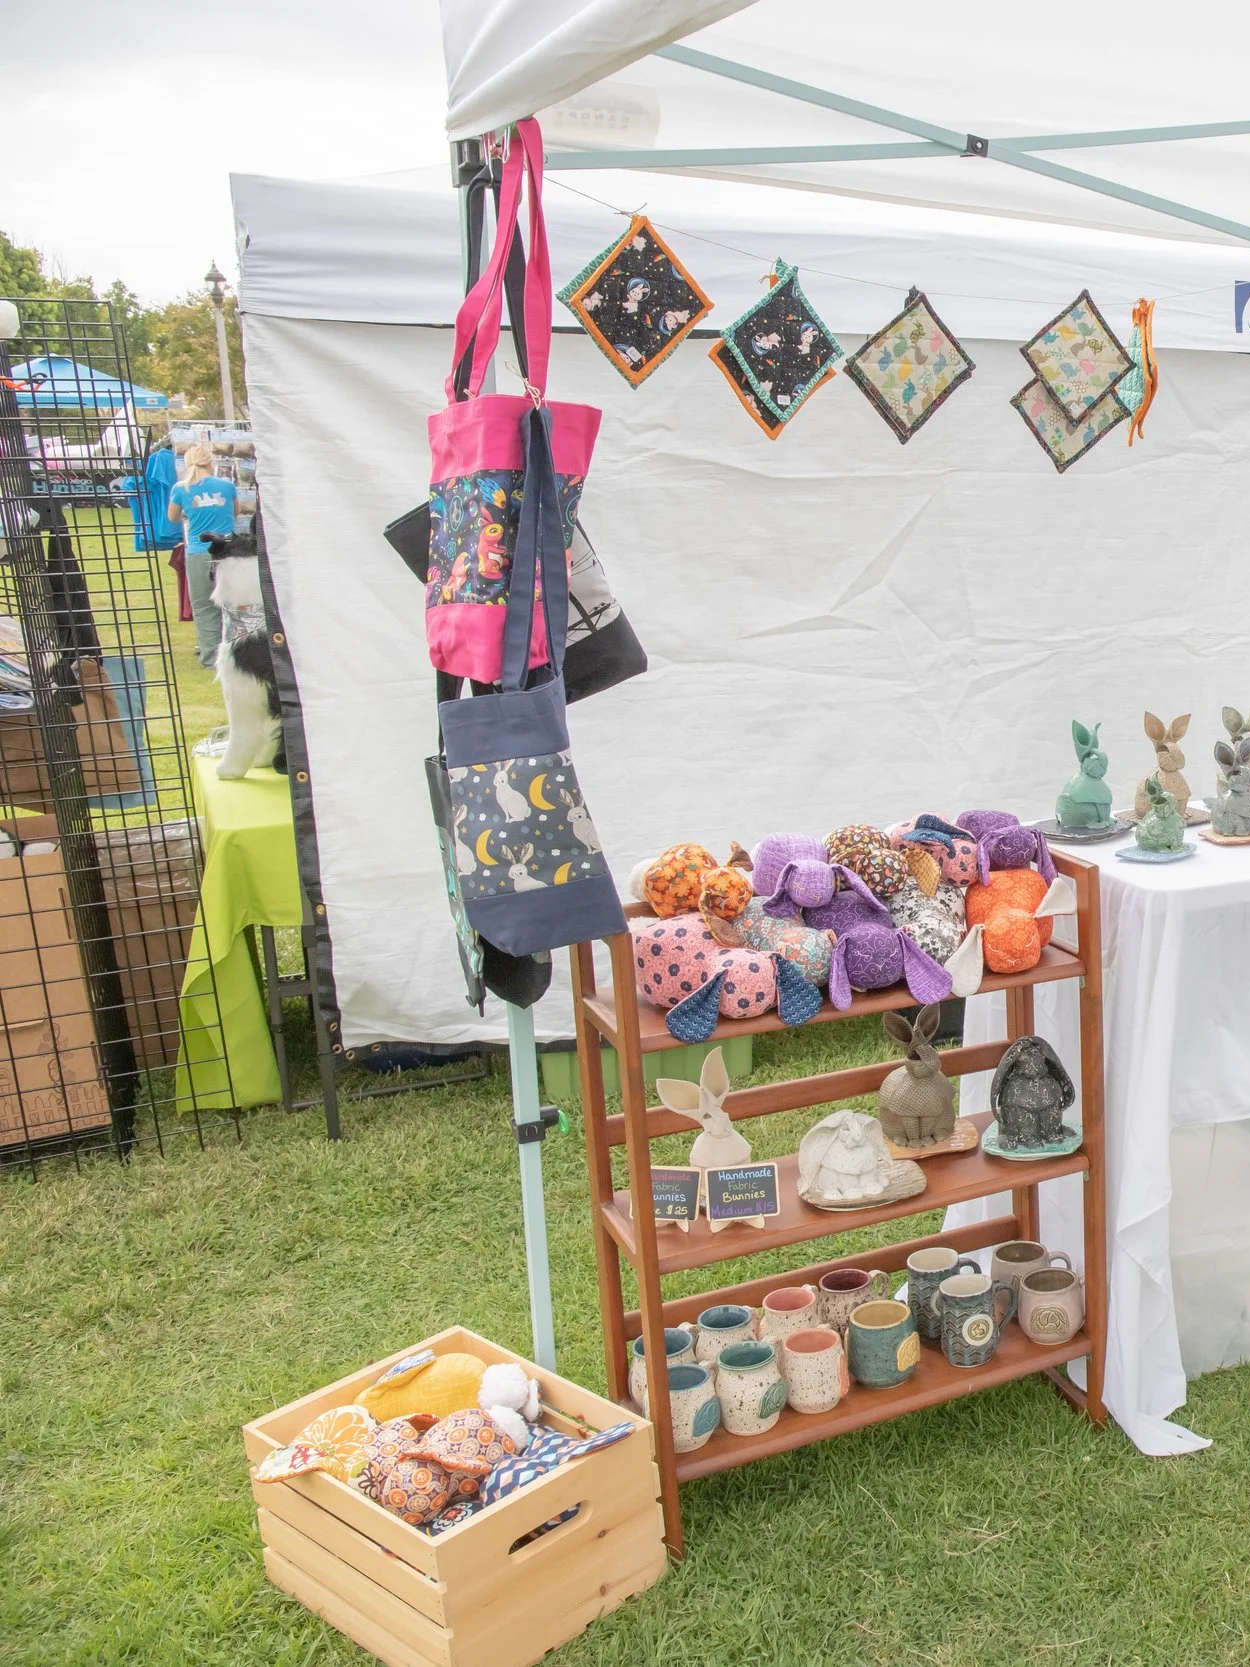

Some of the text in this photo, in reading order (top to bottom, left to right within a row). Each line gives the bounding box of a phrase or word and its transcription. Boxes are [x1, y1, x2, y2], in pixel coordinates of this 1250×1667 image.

[718, 1167, 773, 1182] Handmade
[728, 1180, 758, 1191] Fabric
[653, 1192, 687, 1202] unnies
[722, 1190, 766, 1203] Bunnies
[711, 1204, 753, 1218] Medium
